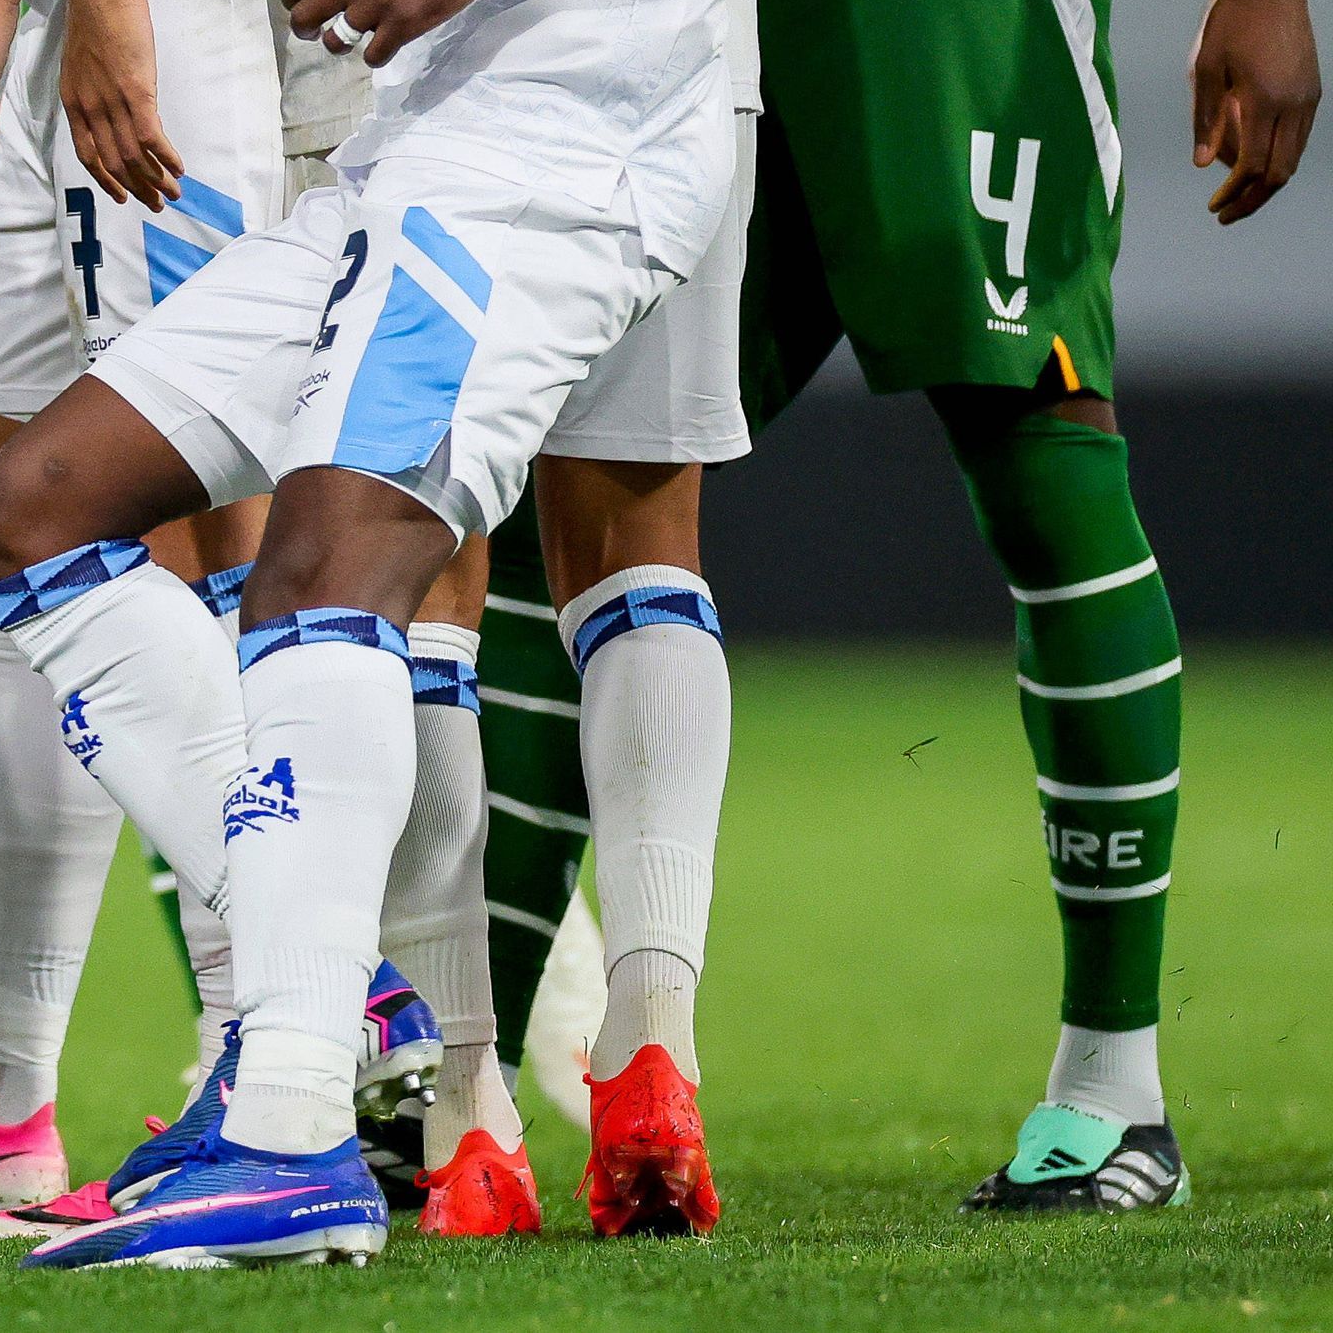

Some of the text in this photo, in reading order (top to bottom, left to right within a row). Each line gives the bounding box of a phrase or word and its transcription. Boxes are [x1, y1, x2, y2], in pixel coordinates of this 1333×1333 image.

[65, 187, 103, 319] 7
[970, 129, 1041, 279] 4
[311, 229, 369, 357] 2
[341, 1199, 376, 1209] ZOOM
